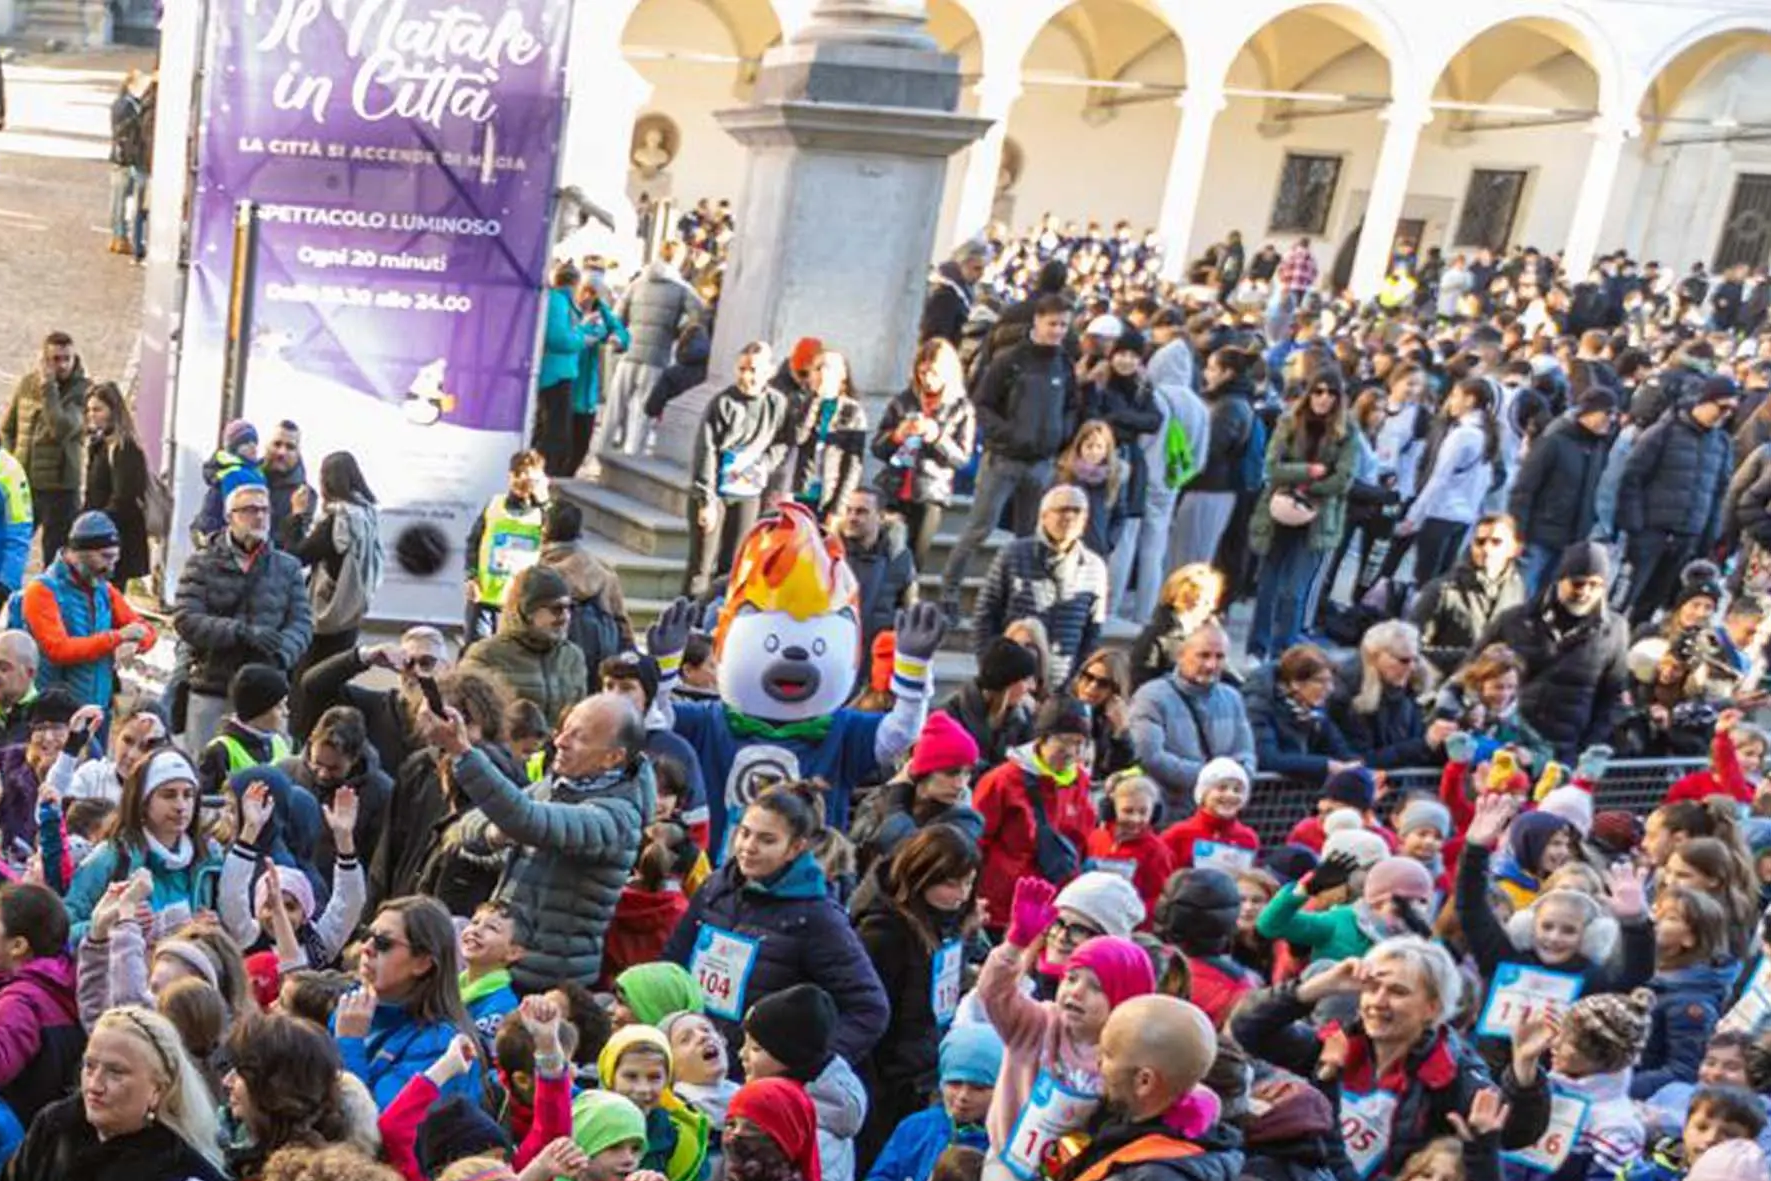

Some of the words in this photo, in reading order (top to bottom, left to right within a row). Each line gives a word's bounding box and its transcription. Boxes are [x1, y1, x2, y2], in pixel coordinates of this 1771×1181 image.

[331, 0, 542, 68] Natale
[272, 61, 332, 124] in
[352, 49, 499, 129] Città
[238, 136, 264, 153] LA
[268, 137, 321, 158] CITTÀ
[467, 155, 527, 172] MGIA
[390, 213, 501, 237] LUMINOSO
[297, 246, 348, 271] Ogni
[350, 249, 377, 268] 20
[379, 251, 448, 273] minuti
[414, 293, 472, 313] 24.00
[698, 969, 731, 999] 104
[1342, 1116, 1377, 1151] 05
